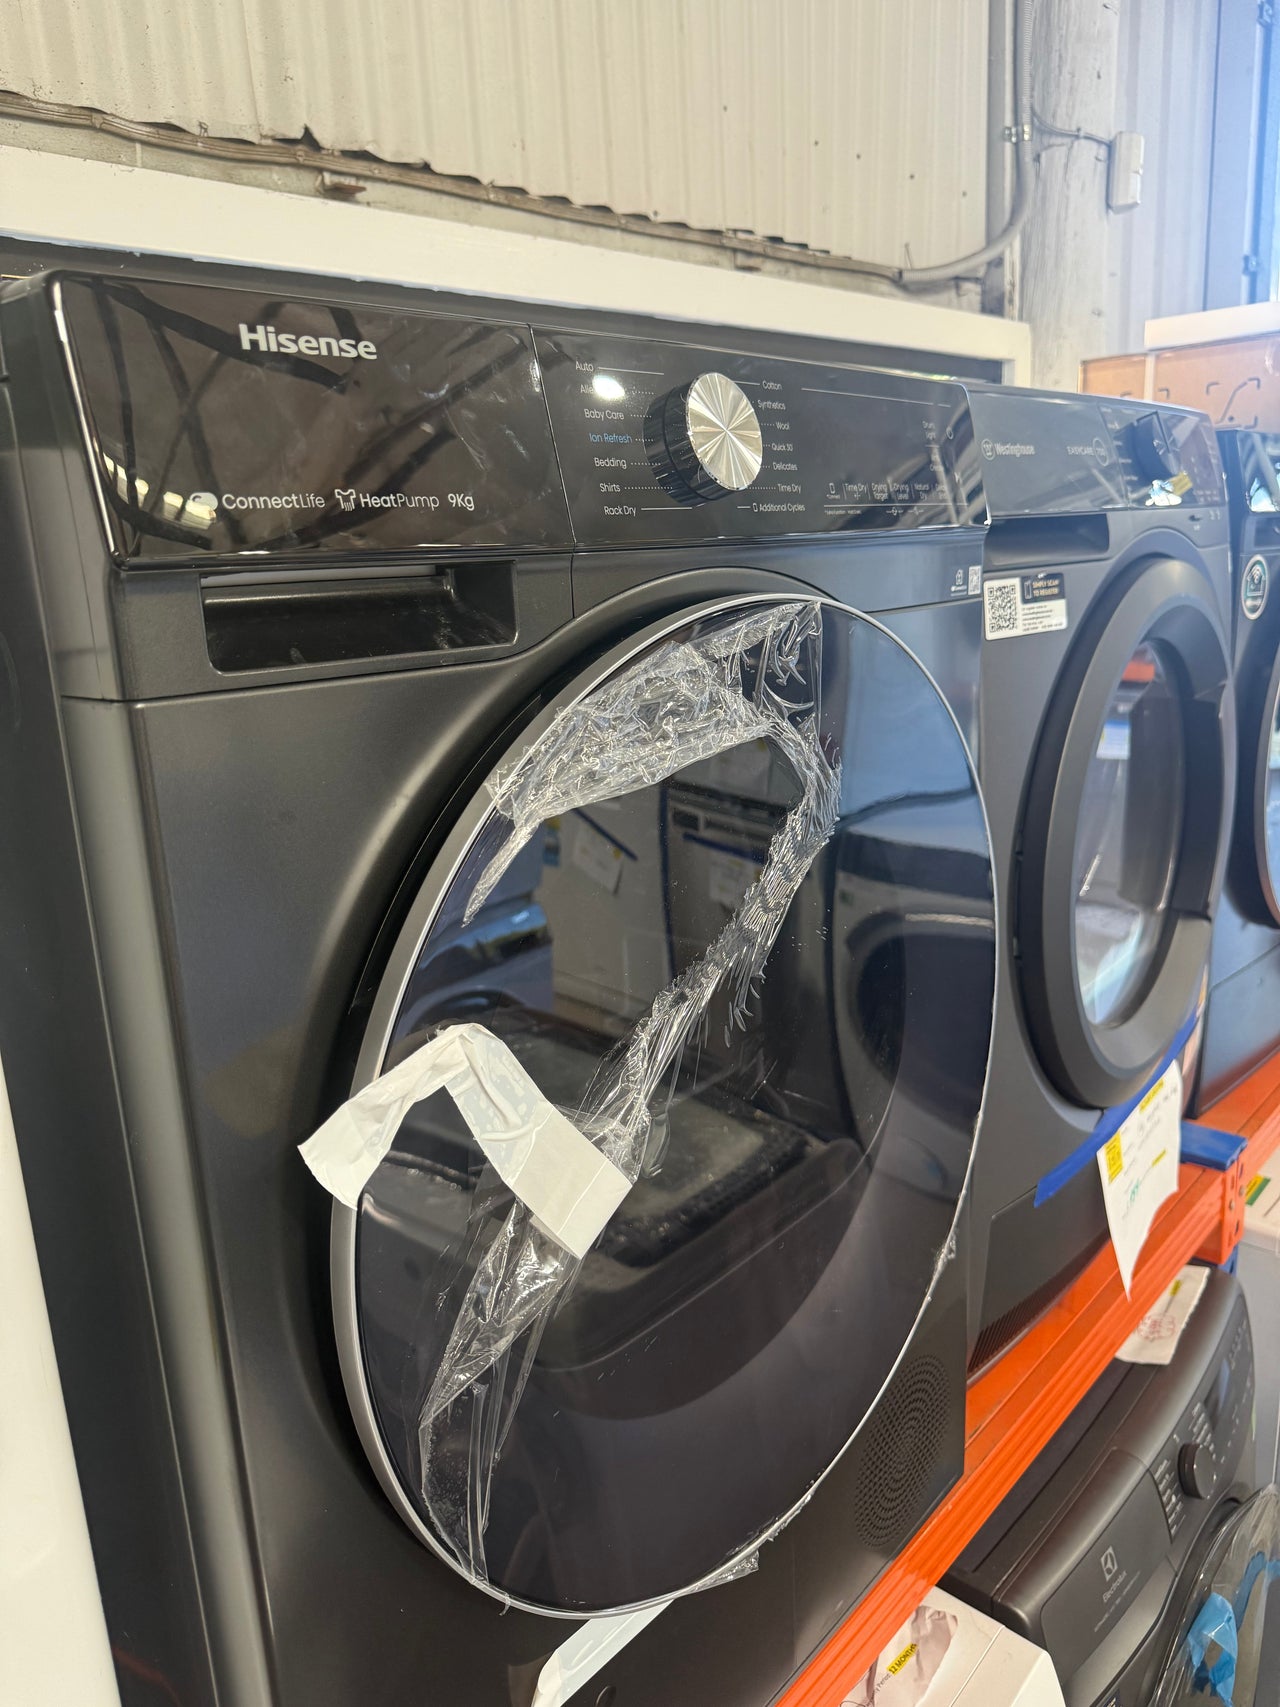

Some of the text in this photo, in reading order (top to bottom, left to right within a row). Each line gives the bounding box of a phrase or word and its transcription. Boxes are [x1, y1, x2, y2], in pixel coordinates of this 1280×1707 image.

[238, 323, 378, 360] Hisense
[575, 361, 594, 372] Auto
[762, 380, 782, 390] Cotton
[758, 400, 786, 411] Synthetics
[584, 408, 625, 421] Baby Care
[776, 421, 790, 430] Wool
[589, 433, 633, 444] Ion Refresh
[772, 444, 786, 452] Quick
[994, 443, 1036, 458] Westinghouse
[594, 457, 627, 469] Bedding
[773, 462, 798, 471] Delicates
[600, 482, 621, 492] Shirts
[778, 483, 802, 494] Time Dry
[845, 483, 867, 494] Time Dry
[222, 493, 326, 510] ConnectLife
[359, 493, 475, 511] HeatPump 9Kg
[604, 506, 637, 517] Rack Dry
[759, 503, 805, 513] Additional Cycles
[888, 1665, 897, 1674] 12
